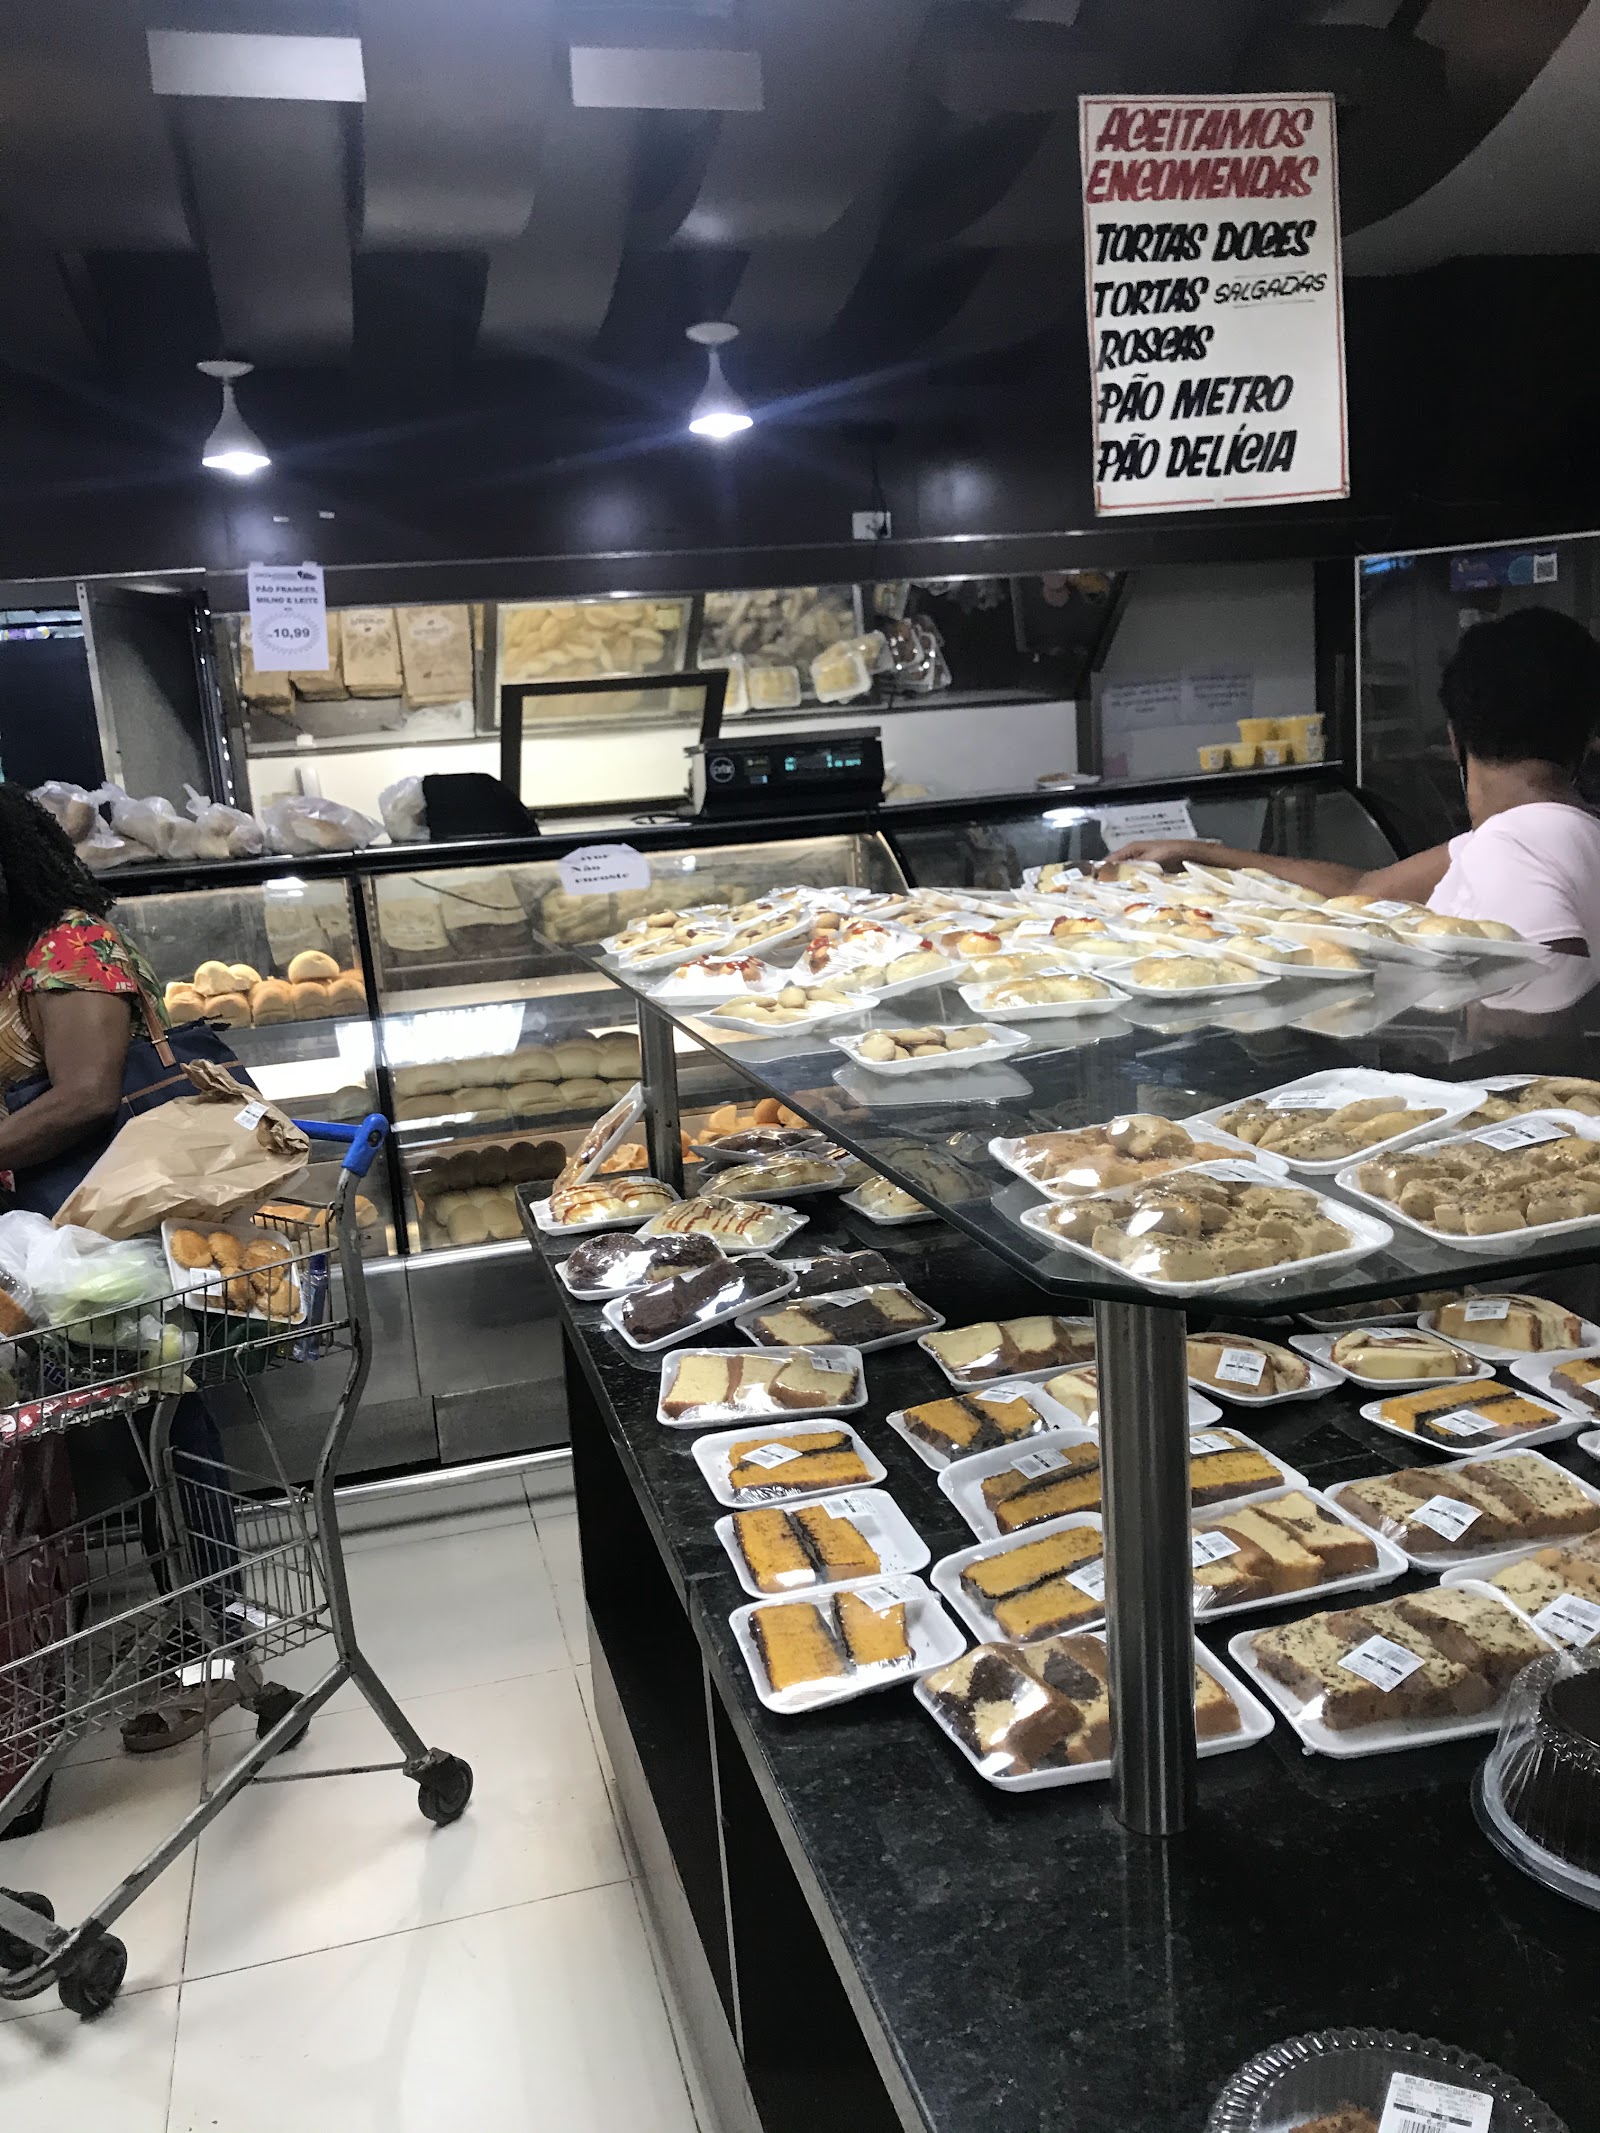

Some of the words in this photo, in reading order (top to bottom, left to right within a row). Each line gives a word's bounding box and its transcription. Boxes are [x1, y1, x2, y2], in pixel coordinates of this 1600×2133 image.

[1095, 107, 1313, 153] ACEITAMOS
[1086, 155, 1319, 203] ENCOMENDAS
[1096, 222, 1207, 265] TORTAS
[1212, 219, 1317, 262] DOCES
[1094, 277, 1209, 317] TORTAS
[1214, 273, 1328, 304] SALGADAS
[1097, 324, 1214, 372] ROSCAS
[1098, 373, 1165, 424] PÃO
[1170, 374, 1294, 421] METRO
[1097, 432, 1160, 482] PÃO
[1165, 423, 1298, 478] DELÍCIA
